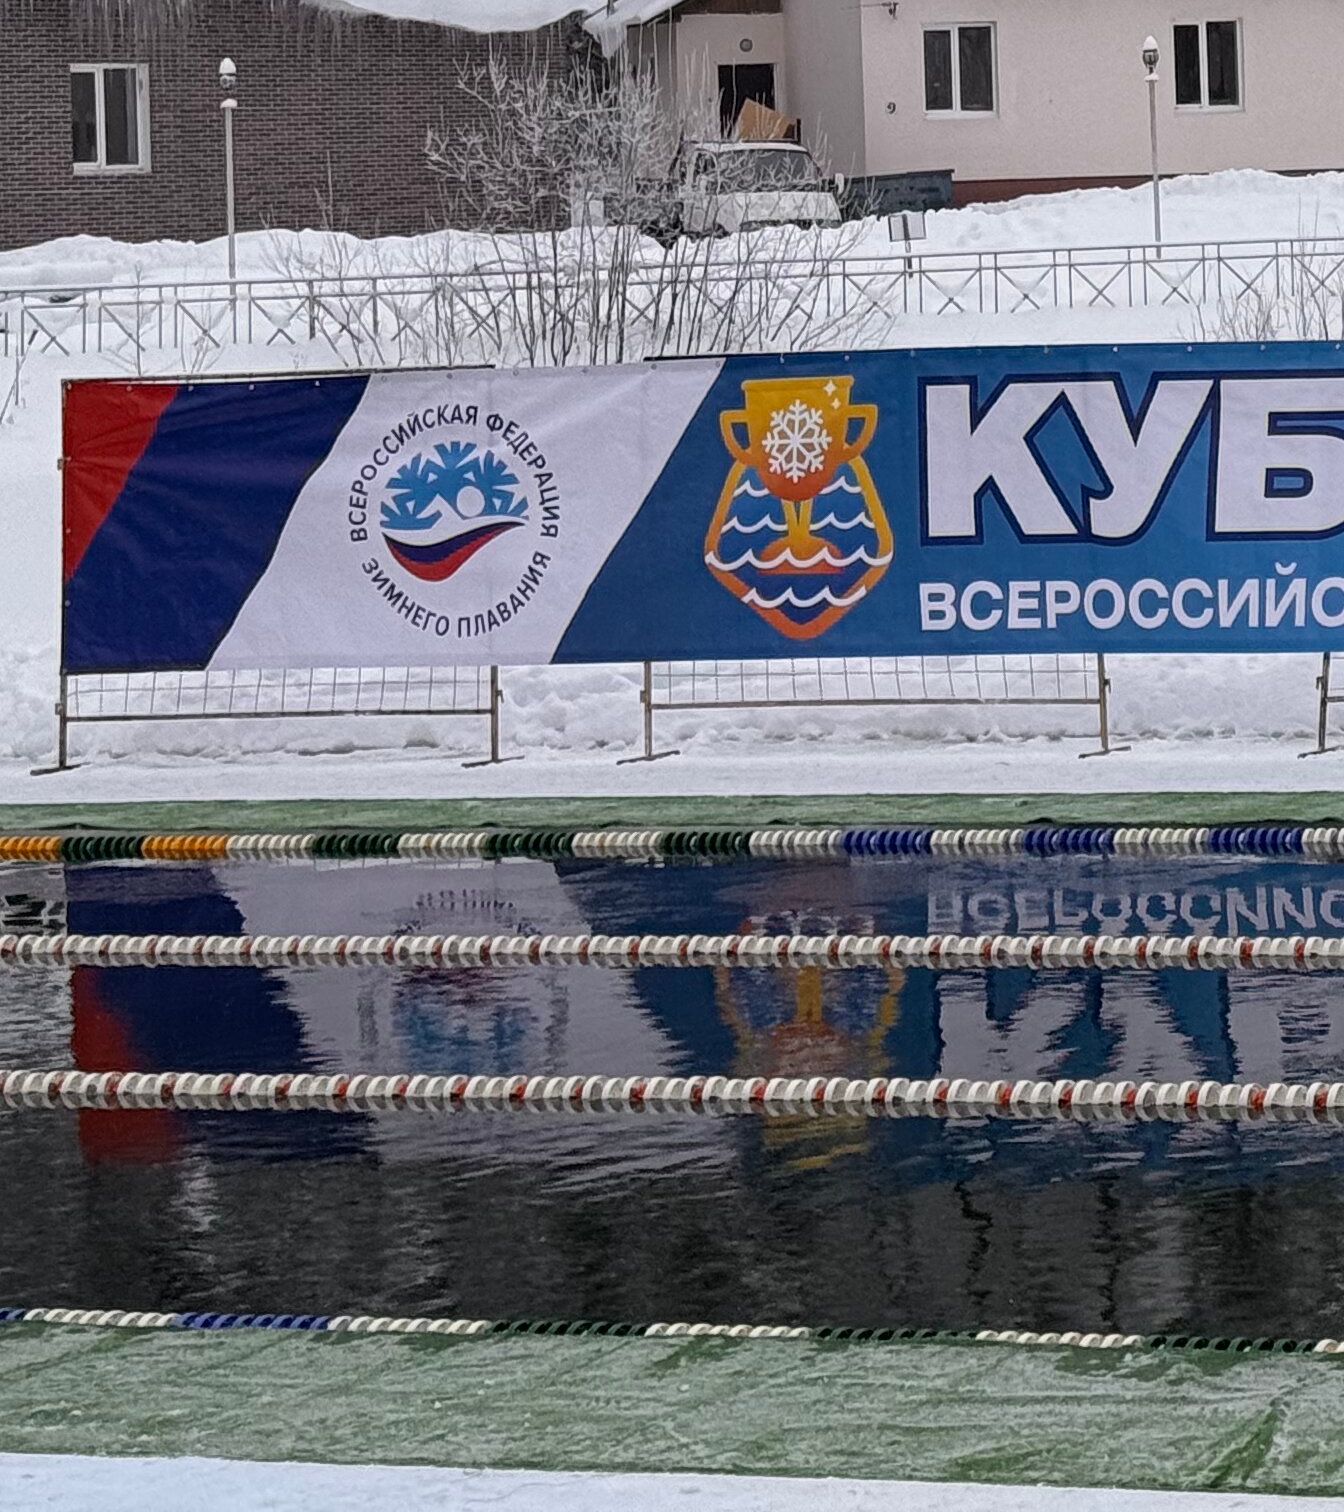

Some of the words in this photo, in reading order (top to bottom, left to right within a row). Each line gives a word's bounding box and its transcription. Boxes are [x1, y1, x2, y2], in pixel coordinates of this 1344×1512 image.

[348, 403, 479, 543] ВСЕРОССИЙСКАЯ
[485, 412, 560, 539] ФЕДЕРАЦИЯ
[361, 556, 451, 637] ЗИМНЕГО
[456, 550, 552, 639] ПЛАВАНИЯ
